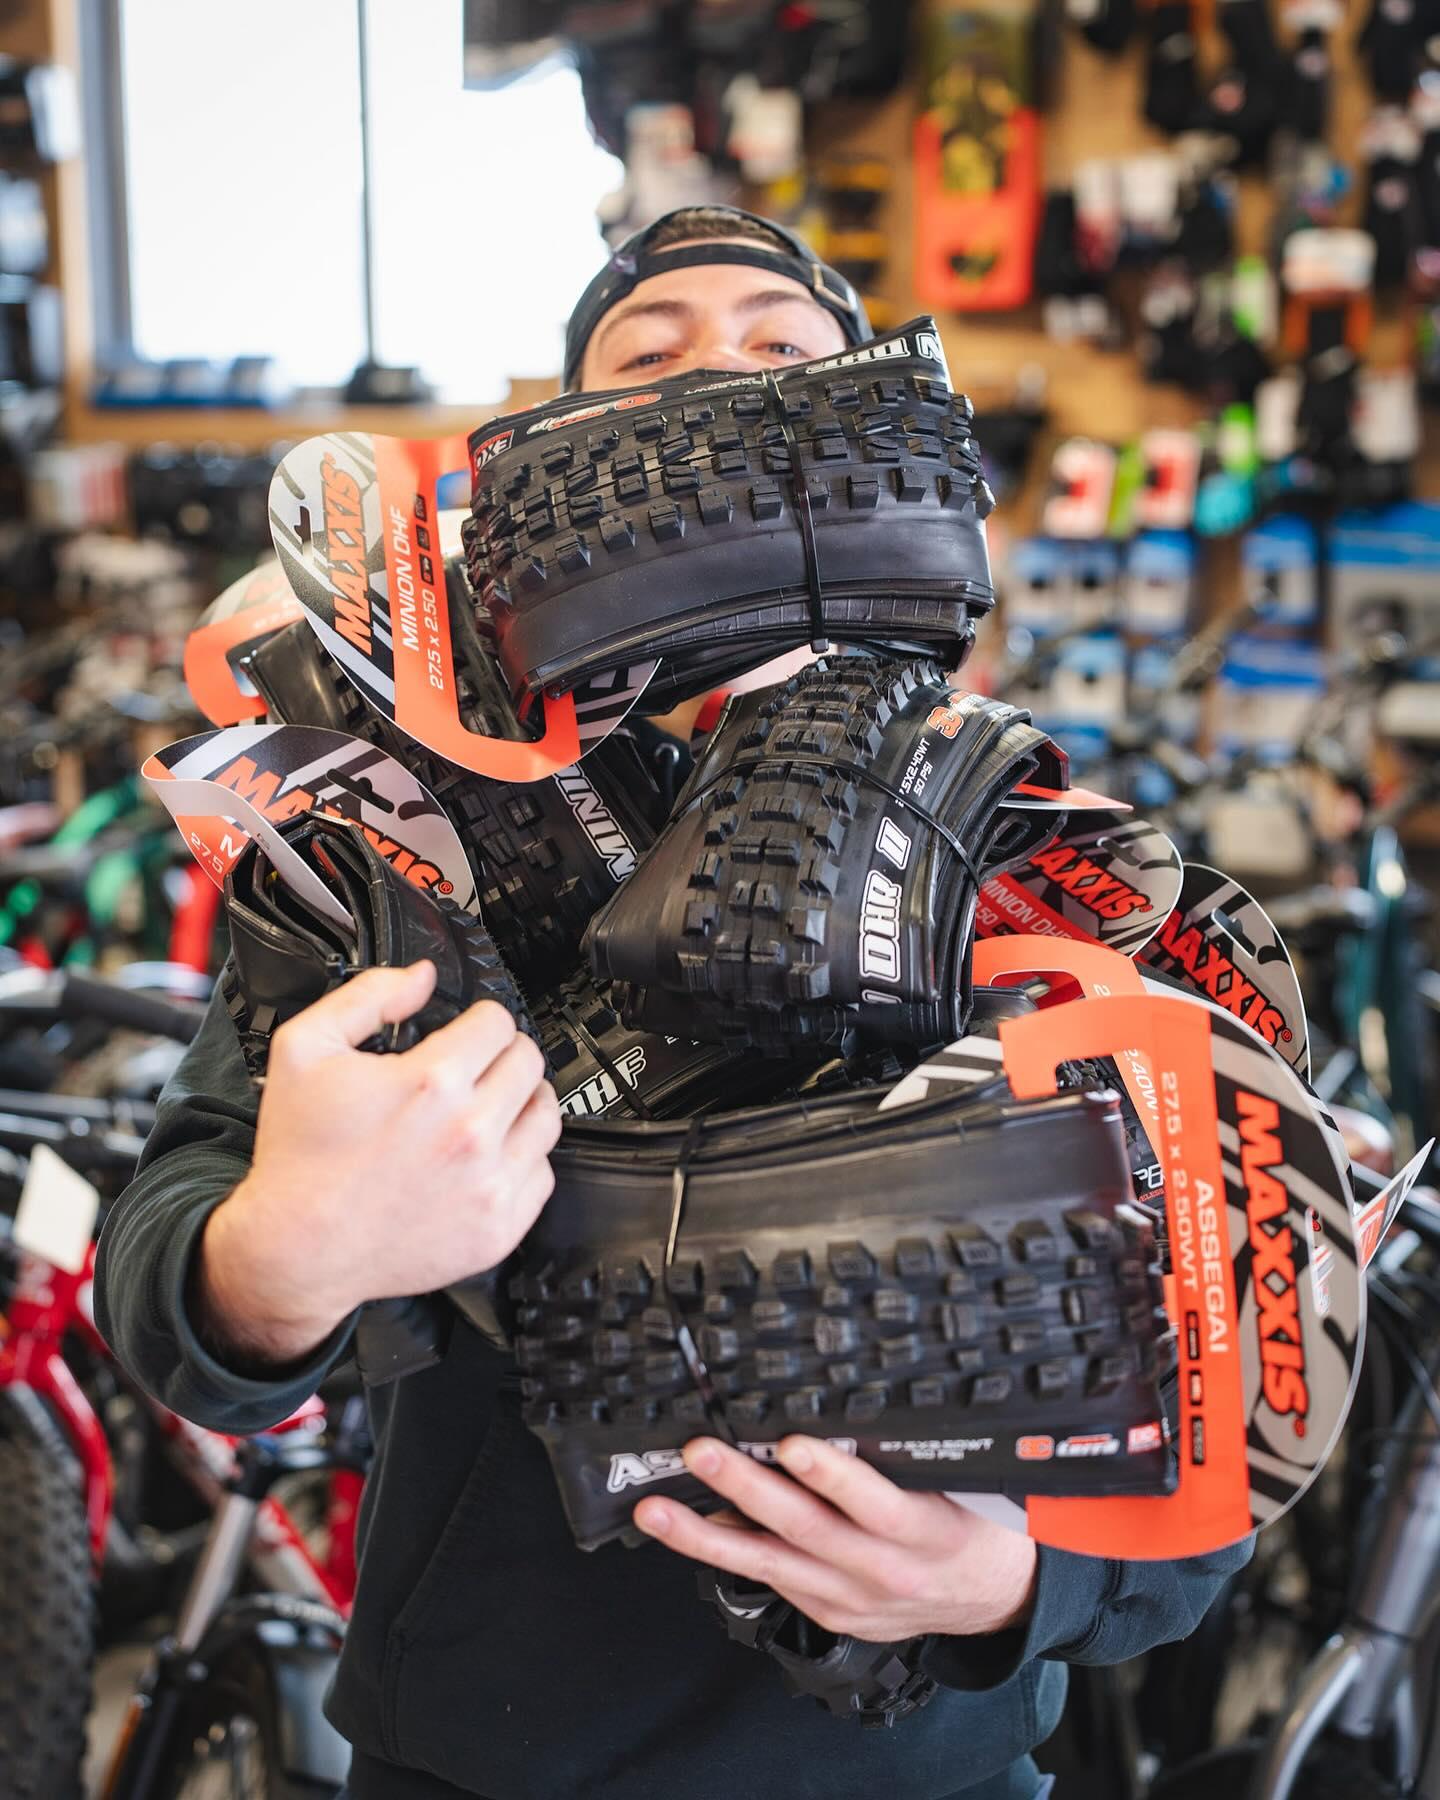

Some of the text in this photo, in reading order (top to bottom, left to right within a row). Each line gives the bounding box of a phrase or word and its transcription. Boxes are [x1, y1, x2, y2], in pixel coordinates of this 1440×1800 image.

[321, 462, 373, 657] MAXXIS
[389, 505, 420, 652] MINION DHF
[421, 590, 439, 634] 2.50
[425, 650, 444, 690] 27.5
[912, 761, 934, 797] 50 PSI
[189, 831, 224, 874] 27.5
[859, 869, 903, 983] DHR
[1160, 1070, 1183, 1135] 27.5
[1171, 1169, 1200, 1293] 2.50WT
[1194, 1179, 1230, 1354] ASSEGAI
[1236, 1090, 1309, 1415] MAXXIS
